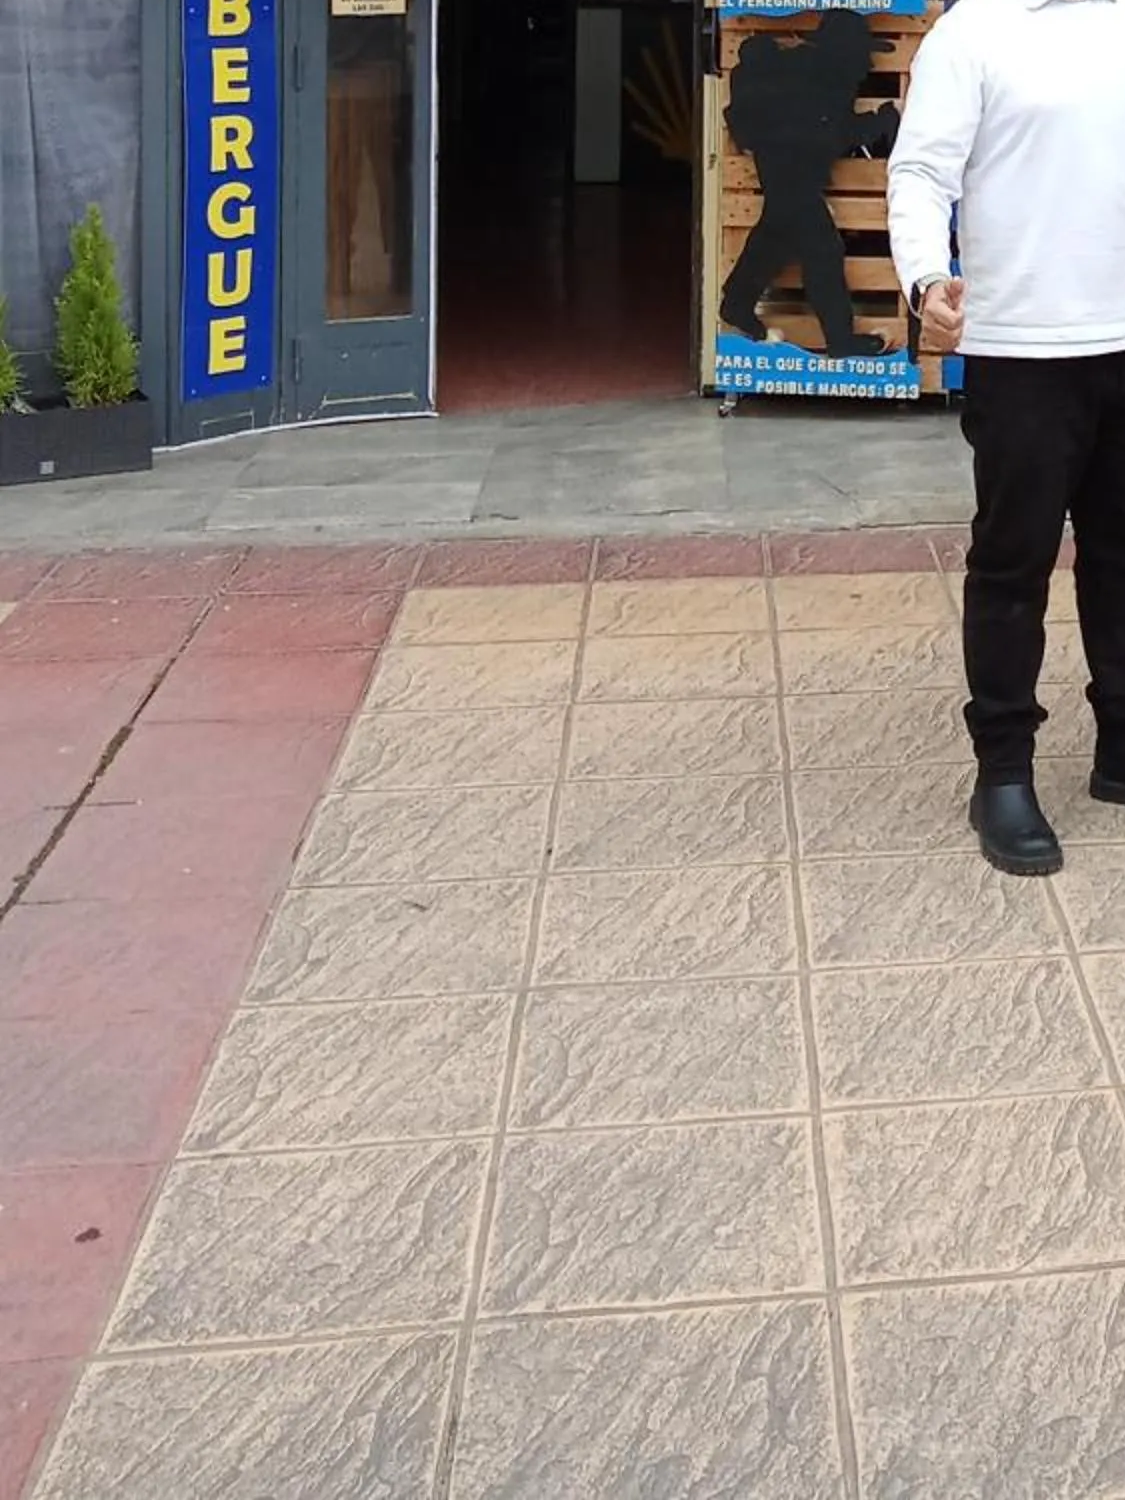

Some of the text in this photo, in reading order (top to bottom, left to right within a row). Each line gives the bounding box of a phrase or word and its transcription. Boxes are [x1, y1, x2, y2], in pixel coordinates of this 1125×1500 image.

[715, 355, 907, 376] PARA EL QUE CREE TODO SE
[715, 373, 753, 387] LE ES
[755, 379, 814, 395] POSIBLE
